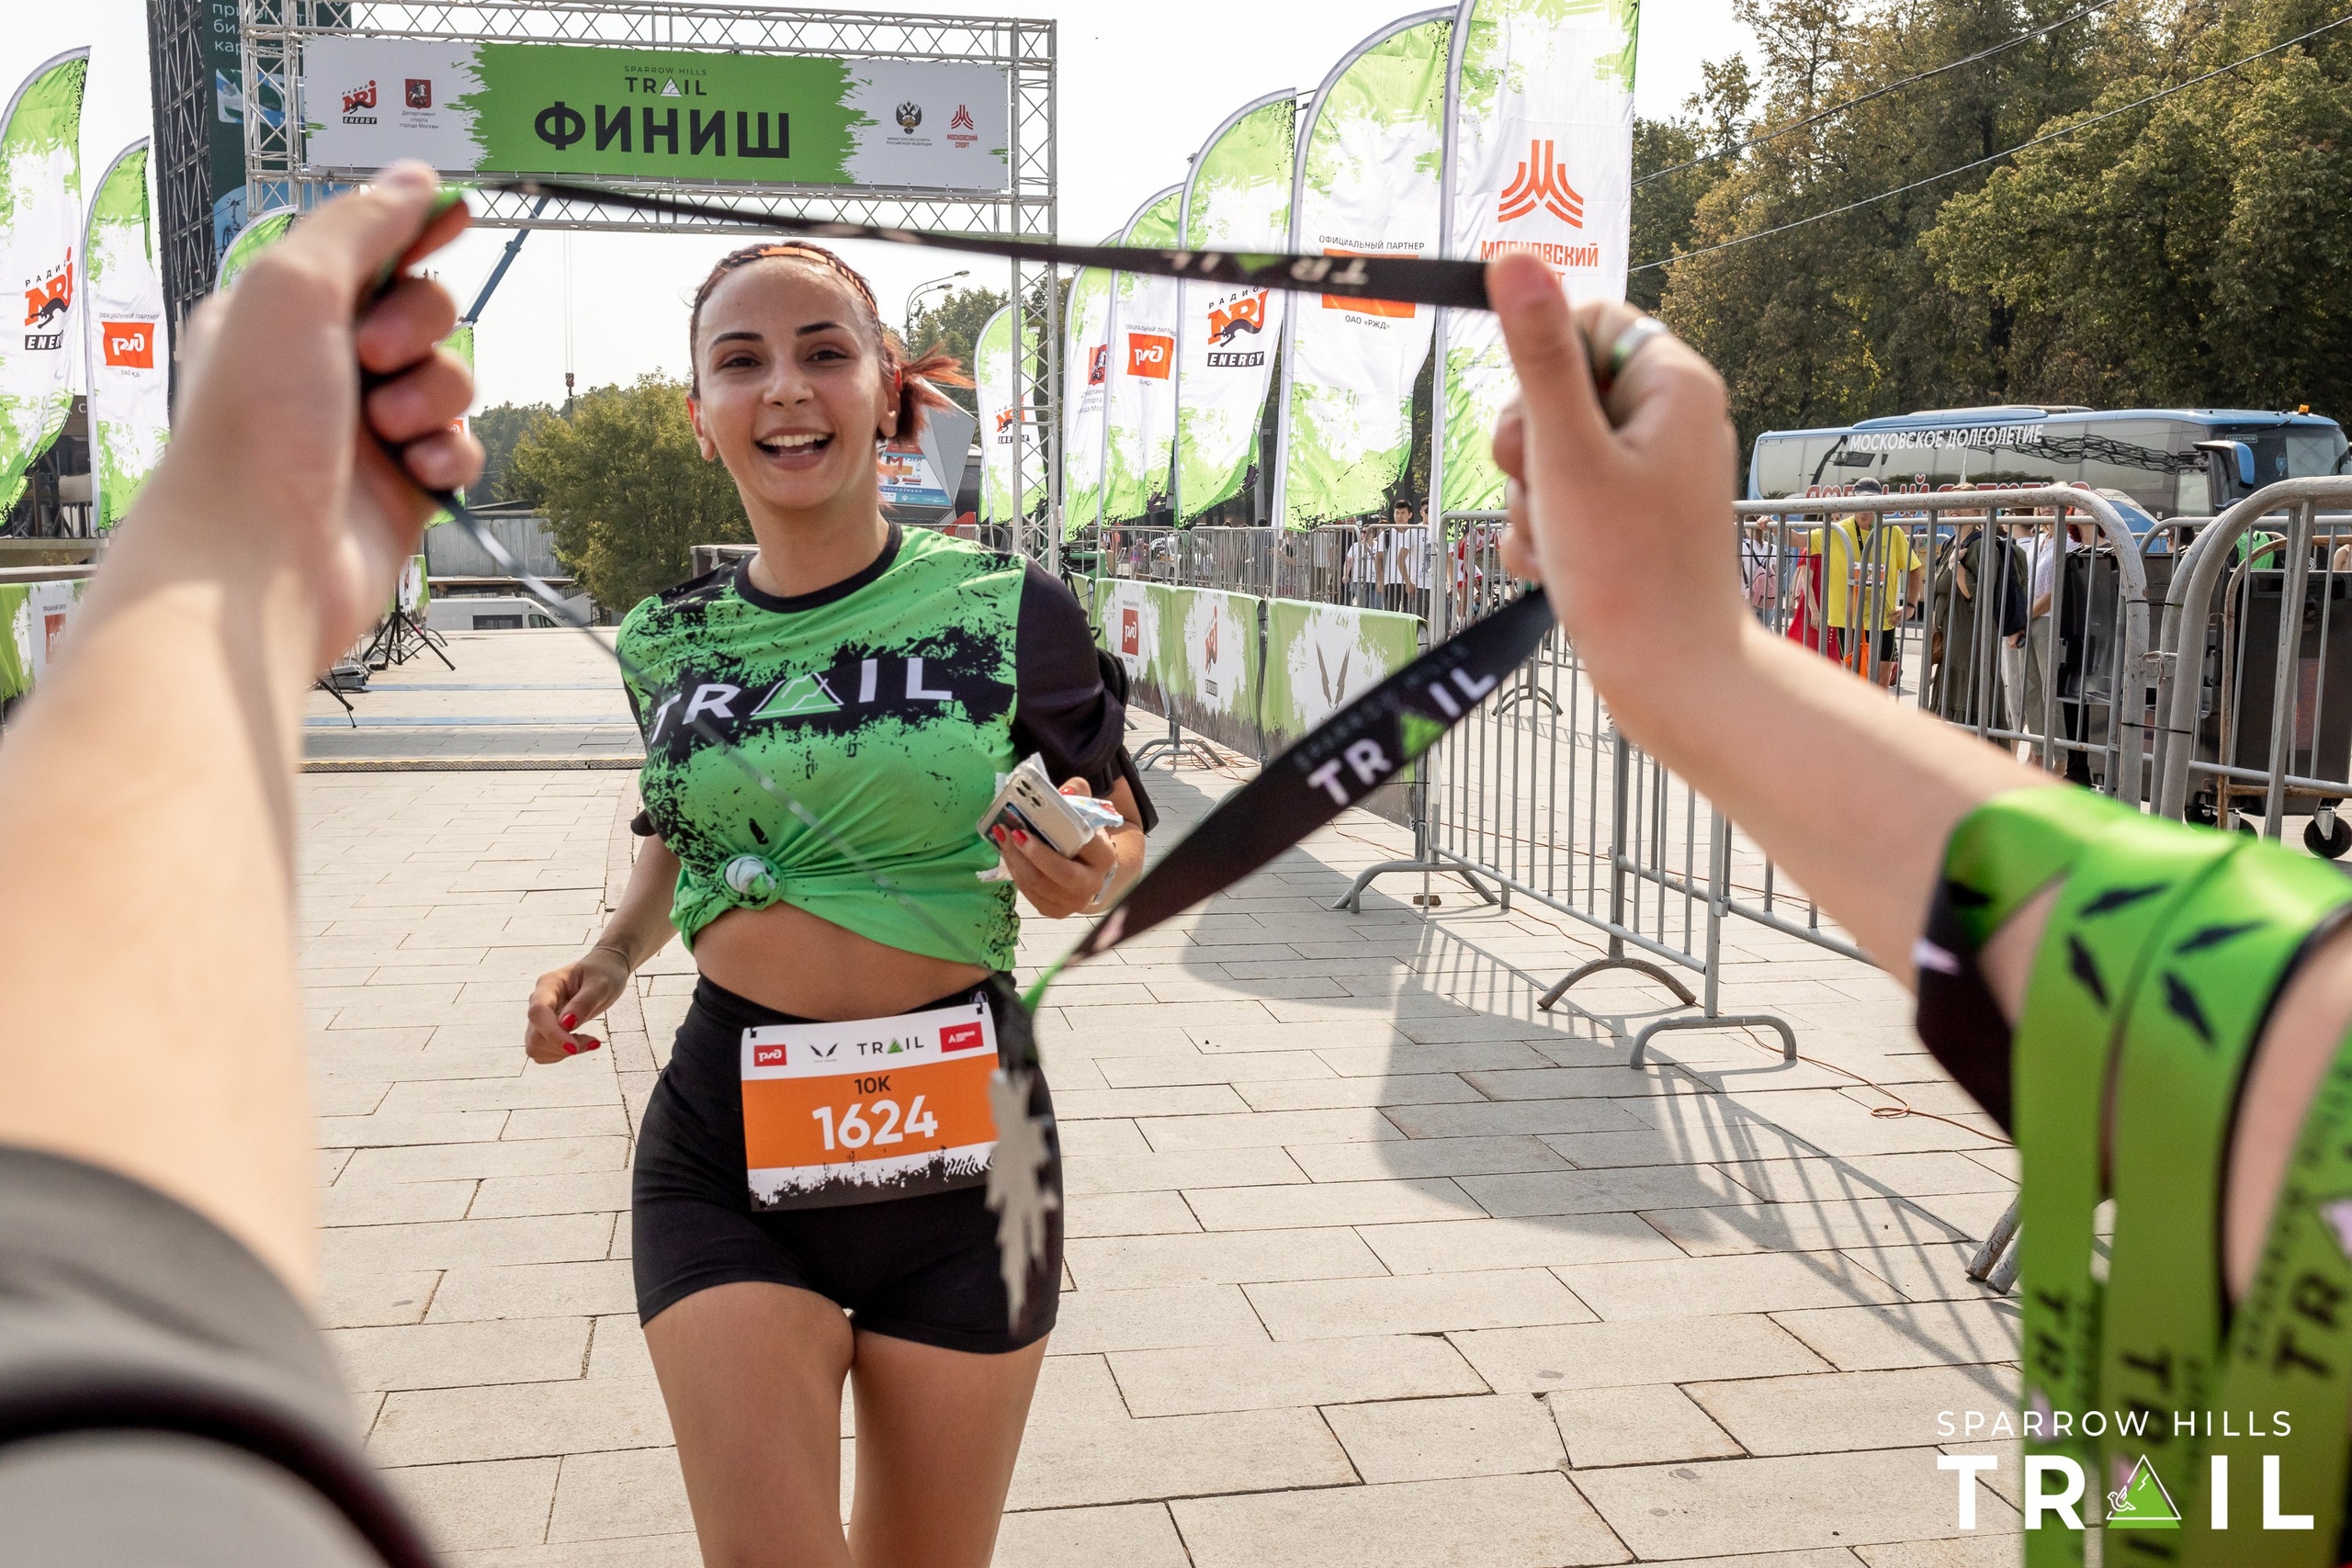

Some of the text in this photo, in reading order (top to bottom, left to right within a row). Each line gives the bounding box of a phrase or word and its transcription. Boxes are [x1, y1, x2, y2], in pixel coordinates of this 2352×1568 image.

[624, 65, 707, 76] SPARROW HILLS
[625, 75, 707, 97] TRAIL
[534, 101, 789, 159] ФИНИШ
[946, 133, 978, 141] МОСКОВСКИЙ
[1319, 235, 1425, 251] ОФИЦИАЛЬНЫЙ ПАРТНЕР
[1208, 286, 1259, 310] РАДИО
[1345, 315, 1390, 331] ОАО «РЖД»
[1209, 353, 1263, 367] ENERGY
[1849, 424, 2044, 452] МОСКОВСКОЕ ДОЛГОЛЕТИЕ
[650, 657, 953, 745] TRAIL
[1306, 667, 1498, 807] TRAIL
[857, 1036, 924, 1056] TRAIL
[854, 1075, 891, 1095] 10K
[812, 1095, 938, 1151] 1624
